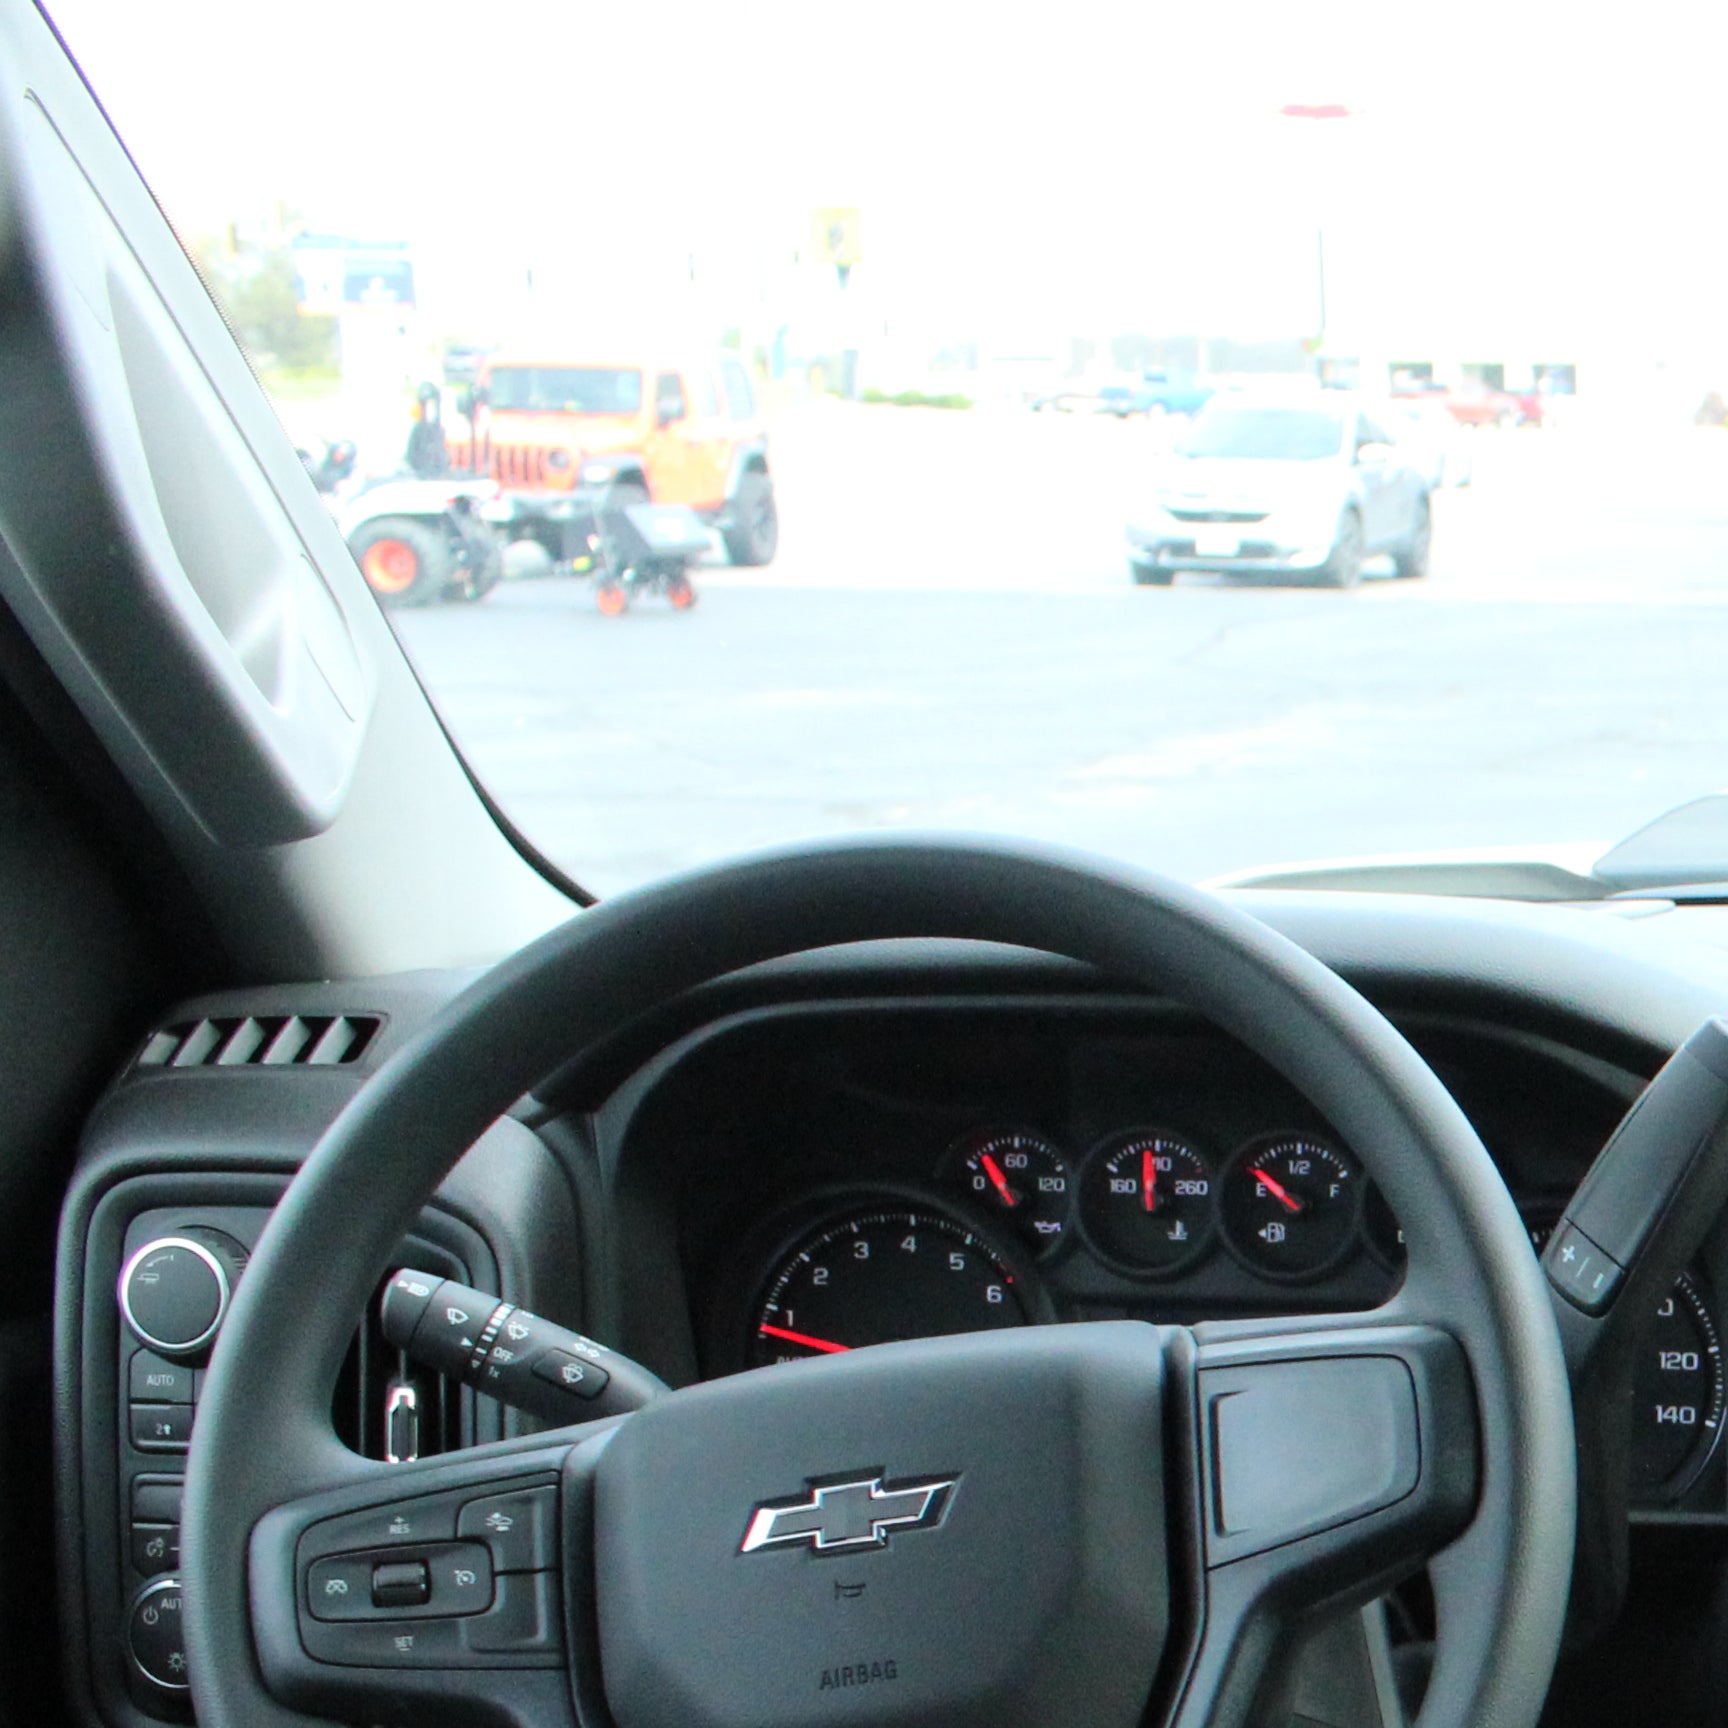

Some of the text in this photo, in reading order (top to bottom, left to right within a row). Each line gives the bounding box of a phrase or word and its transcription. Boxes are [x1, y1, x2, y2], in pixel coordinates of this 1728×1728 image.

[1005, 1153, 1028, 1169] 60
[1288, 1160, 1311, 1175] 1/2
[973, 1175, 985, 1190] 0
[1038, 1177, 1065, 1193] 120
[1109, 1179, 1137, 1194] 160
[1174, 1180, 1209, 1196] 260
[1256, 1183, 1267, 1198] E
[1330, 1184, 1340, 1198] F
[853, 1241, 870, 1260] 3
[901, 1235, 917, 1254] 4
[949, 1252, 965, 1271] 5
[812, 1267, 829, 1285] 2
[986, 1285, 1003, 1303] 6
[786, 1310, 794, 1326] 1
[492, 1346, 514, 1361] OFF
[1659, 1351, 1699, 1371] 120
[146, 1374, 174, 1387] AUTO
[1655, 1405, 1696, 1425] 140
[161, 1598, 182, 1610] AUT
[819, 1660, 898, 1690] AIRBAG
